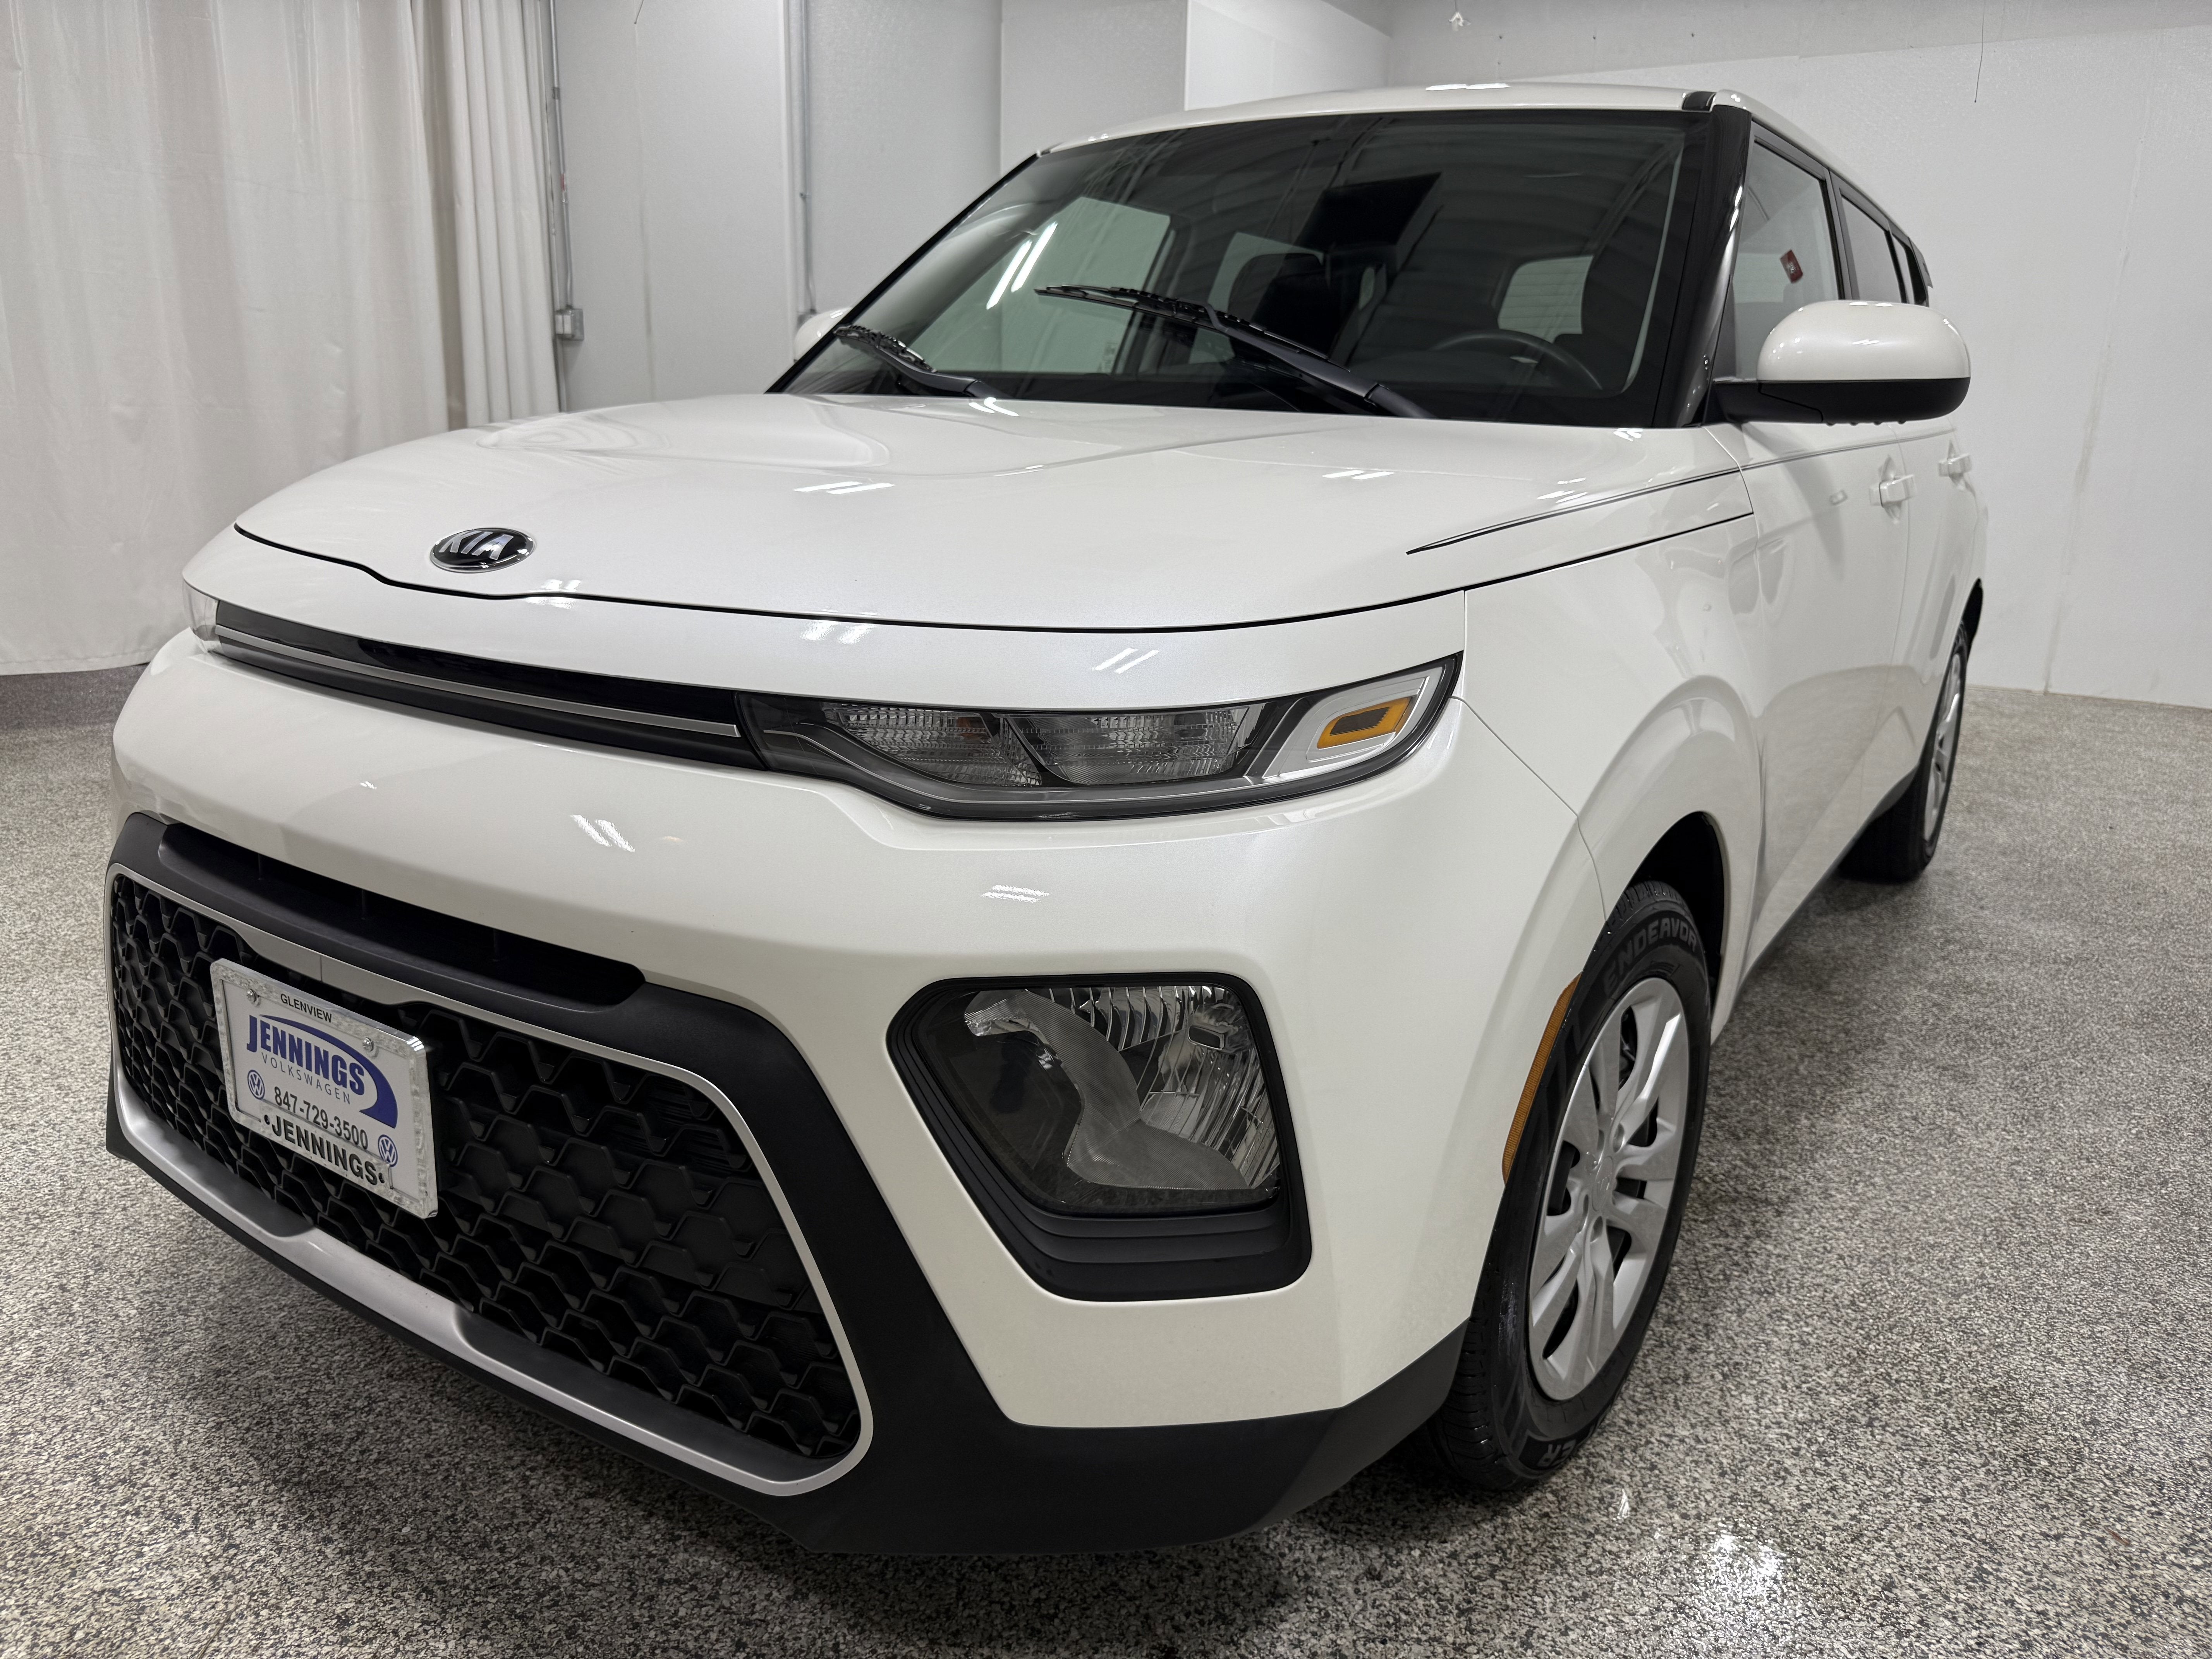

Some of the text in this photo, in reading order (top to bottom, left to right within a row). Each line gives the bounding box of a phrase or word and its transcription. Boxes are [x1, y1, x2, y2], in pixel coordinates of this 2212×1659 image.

[439, 531, 514, 560] KIA
[1603, 917, 1697, 995] ENDEAVOR
[281, 993, 332, 1023] GLENVIEW
[247, 1015, 365, 1096] JENNINGS
[261, 1052, 350, 1105] VOLKSWAGEN
[272, 1115, 378, 1185] JENNINGS
[274, 1086, 368, 1150] 847-729-3500
